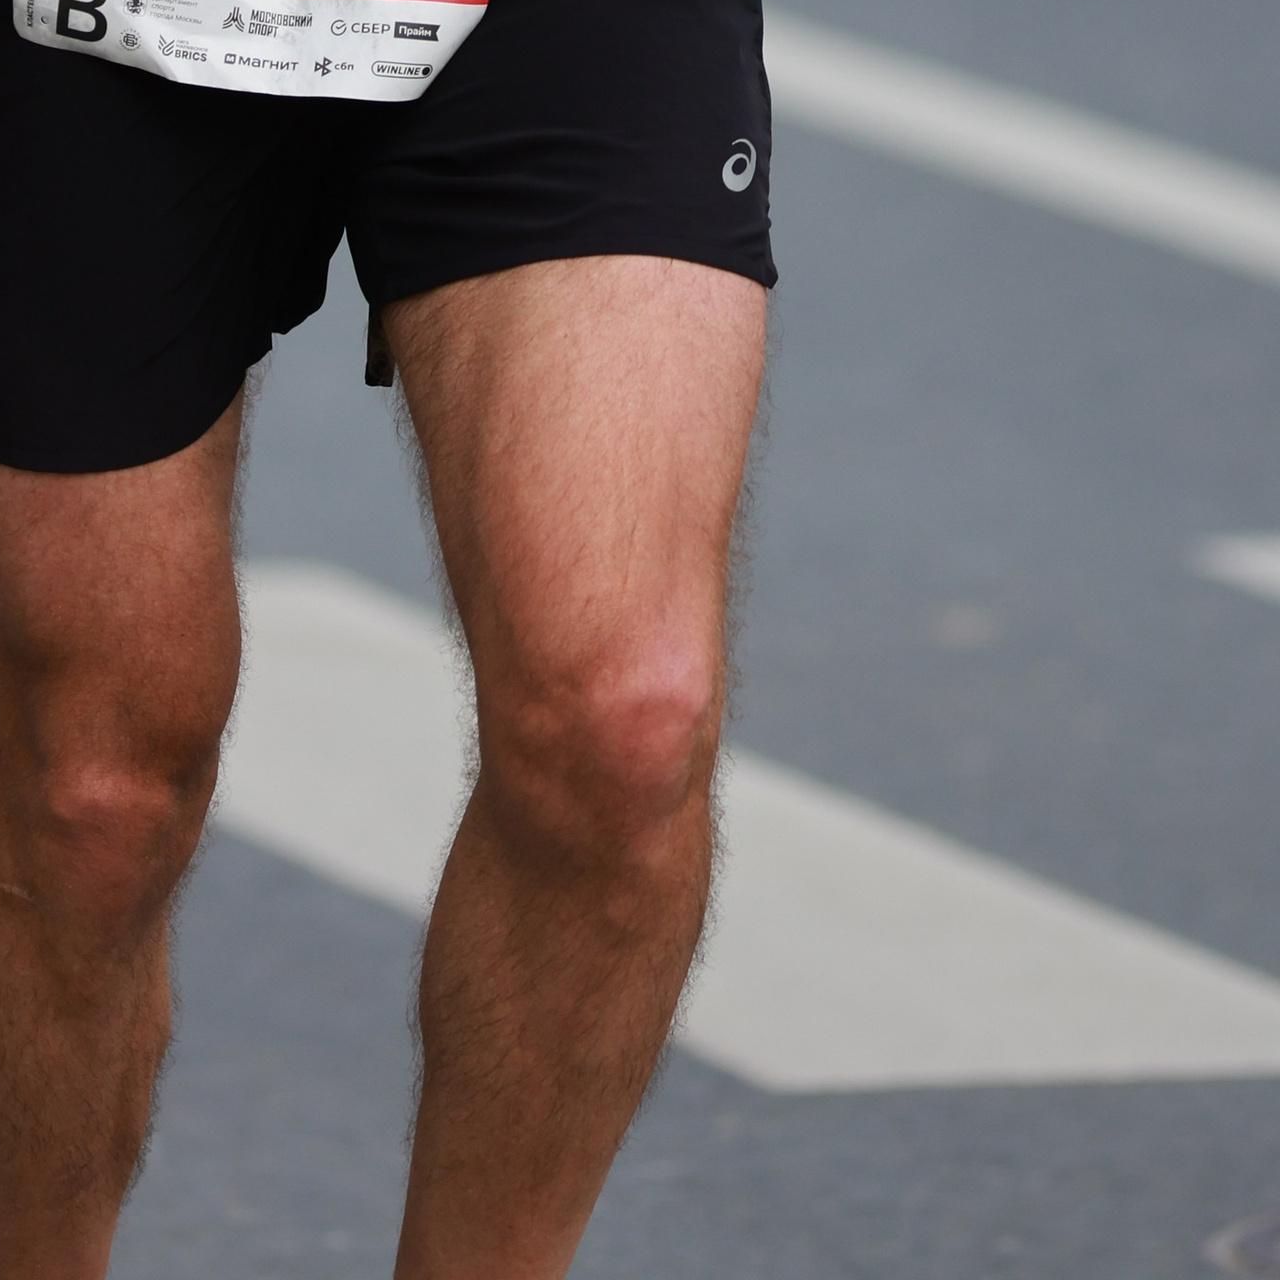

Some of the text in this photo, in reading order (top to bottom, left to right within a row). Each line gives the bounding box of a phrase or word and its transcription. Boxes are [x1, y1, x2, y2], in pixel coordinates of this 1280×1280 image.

[250, 9, 313, 27] МОСКОВСКИЙ
[248, 22, 279, 38] СПОРТ
[351, 22, 432, 37] СБЕР Прайм
[175, 49, 207, 62] BRICS
[334, 62, 354, 71] сбп
[376, 64, 421, 76] WINLINE
